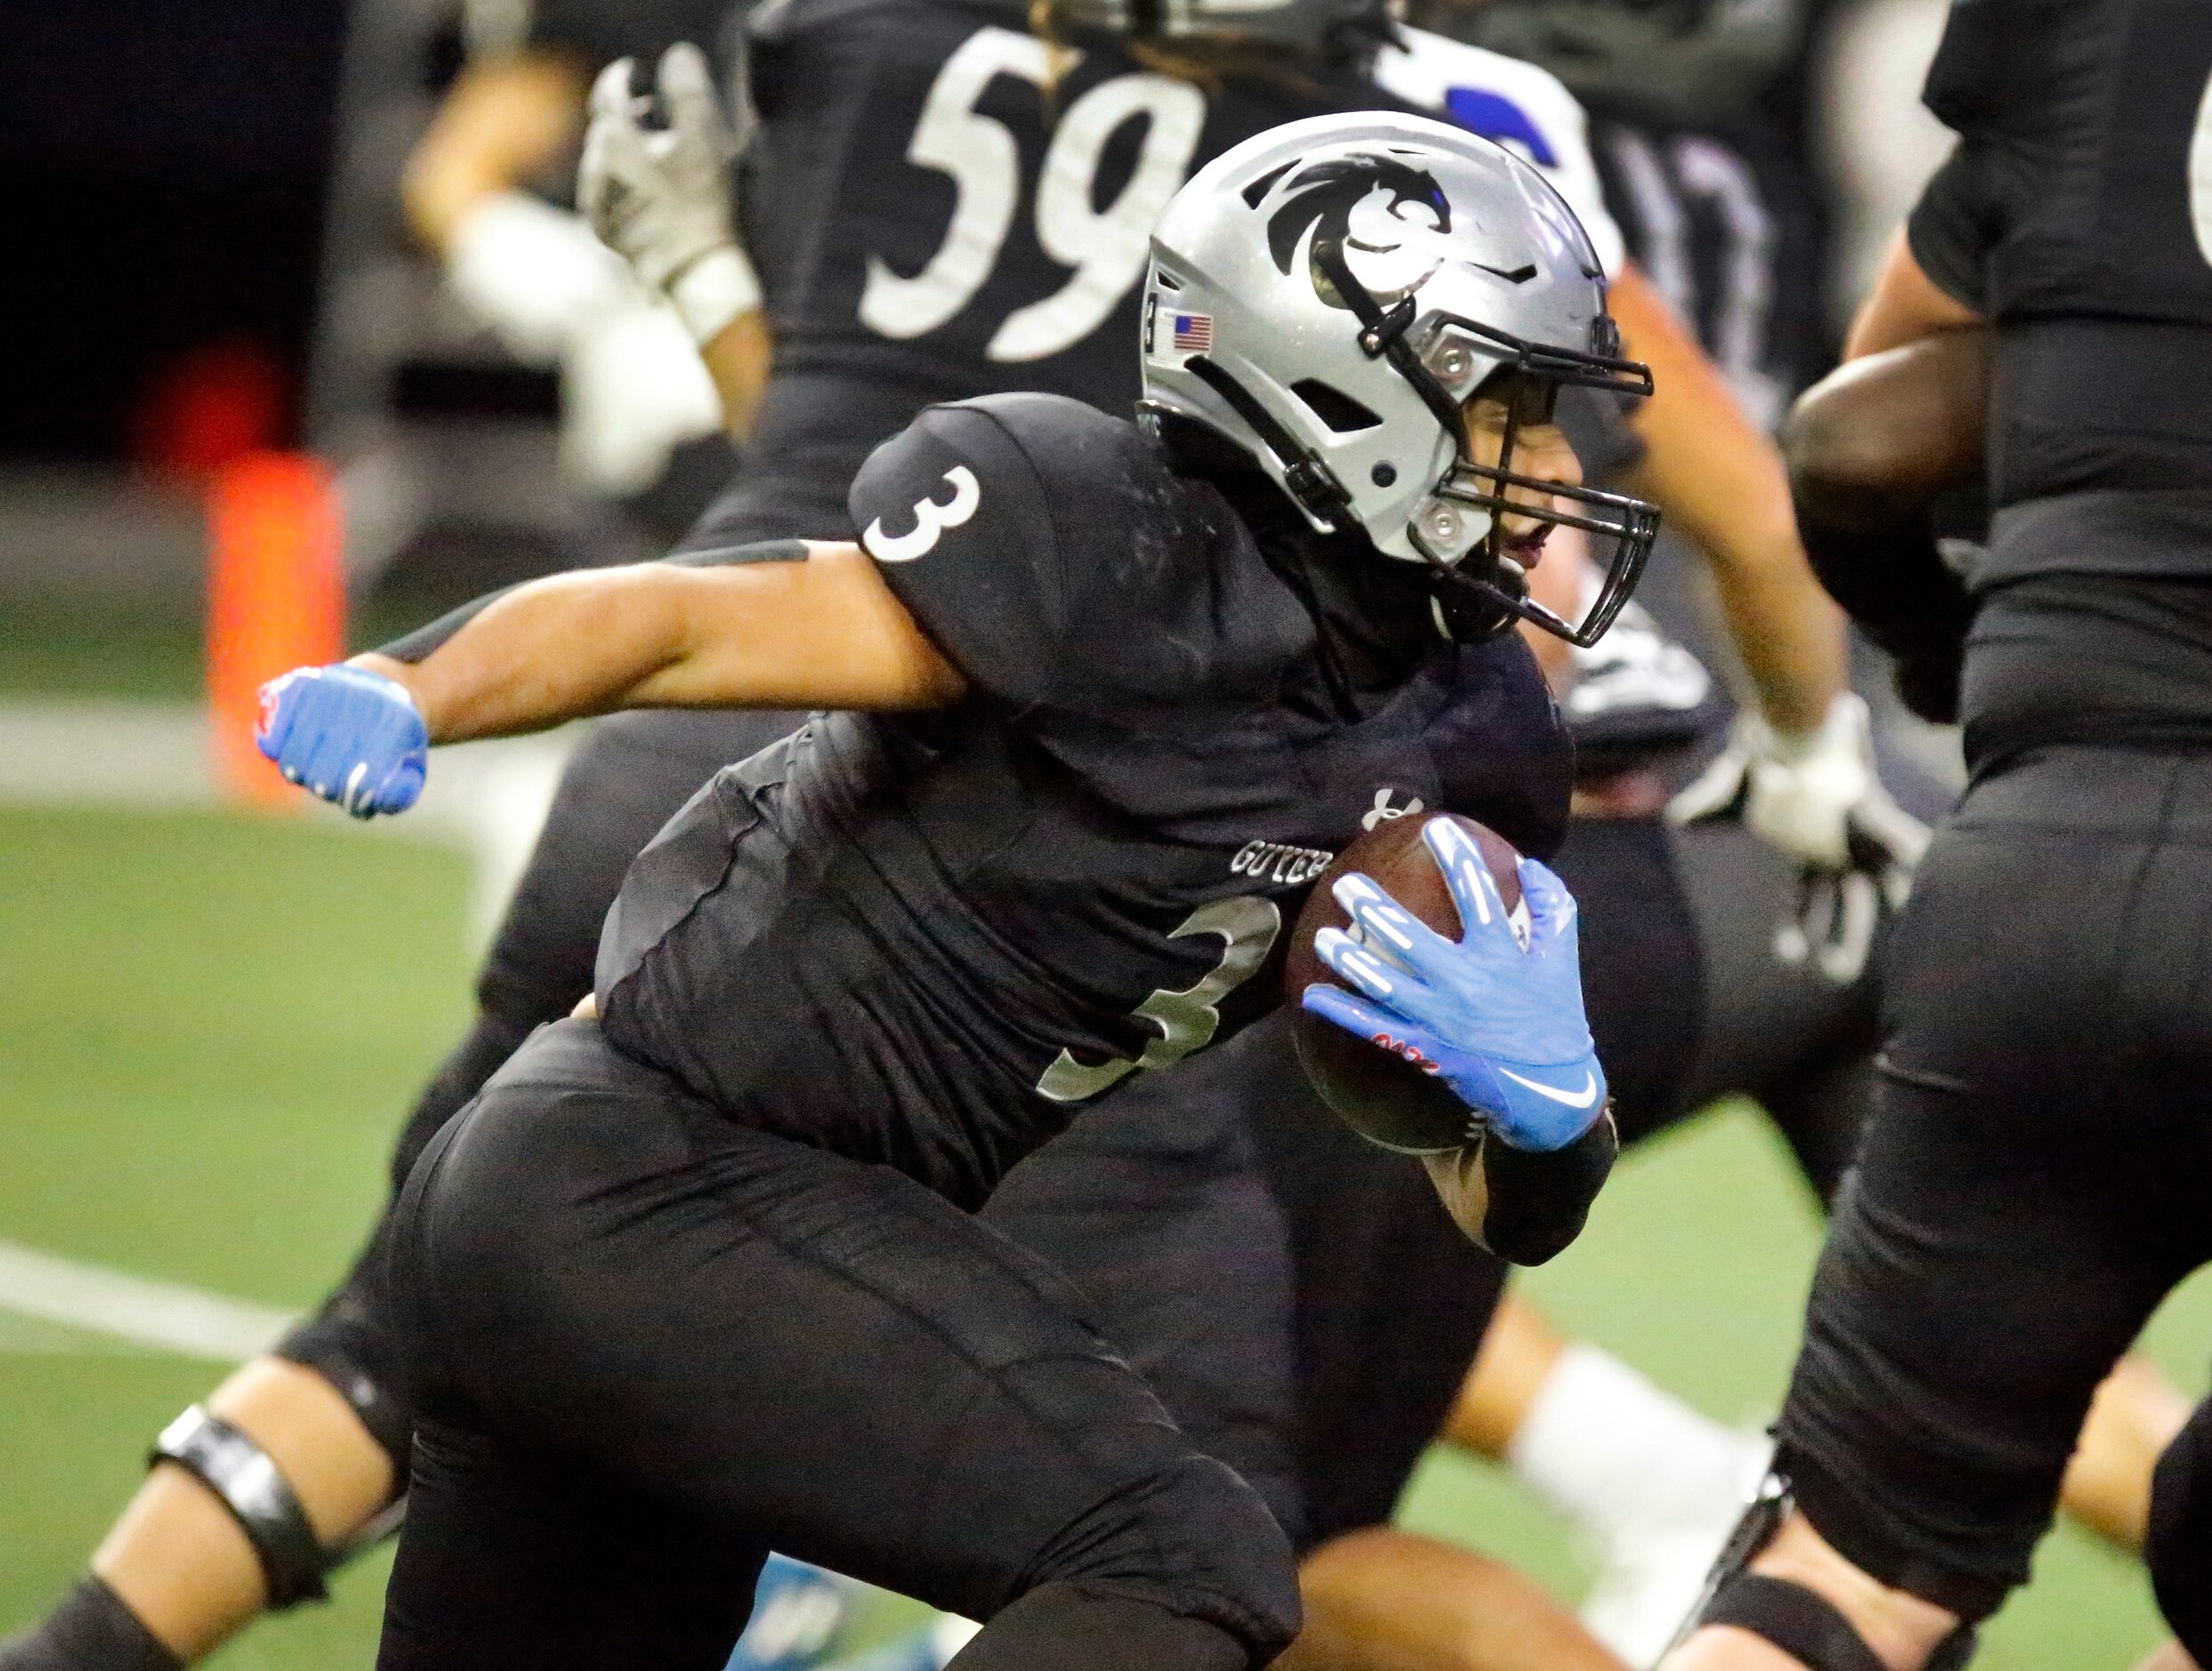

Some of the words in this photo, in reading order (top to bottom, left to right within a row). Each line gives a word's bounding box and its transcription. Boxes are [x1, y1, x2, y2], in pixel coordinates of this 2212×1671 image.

[858, 25, 1207, 363] 59
[863, 465, 980, 562] 3
[1036, 895, 1281, 1102] 3
